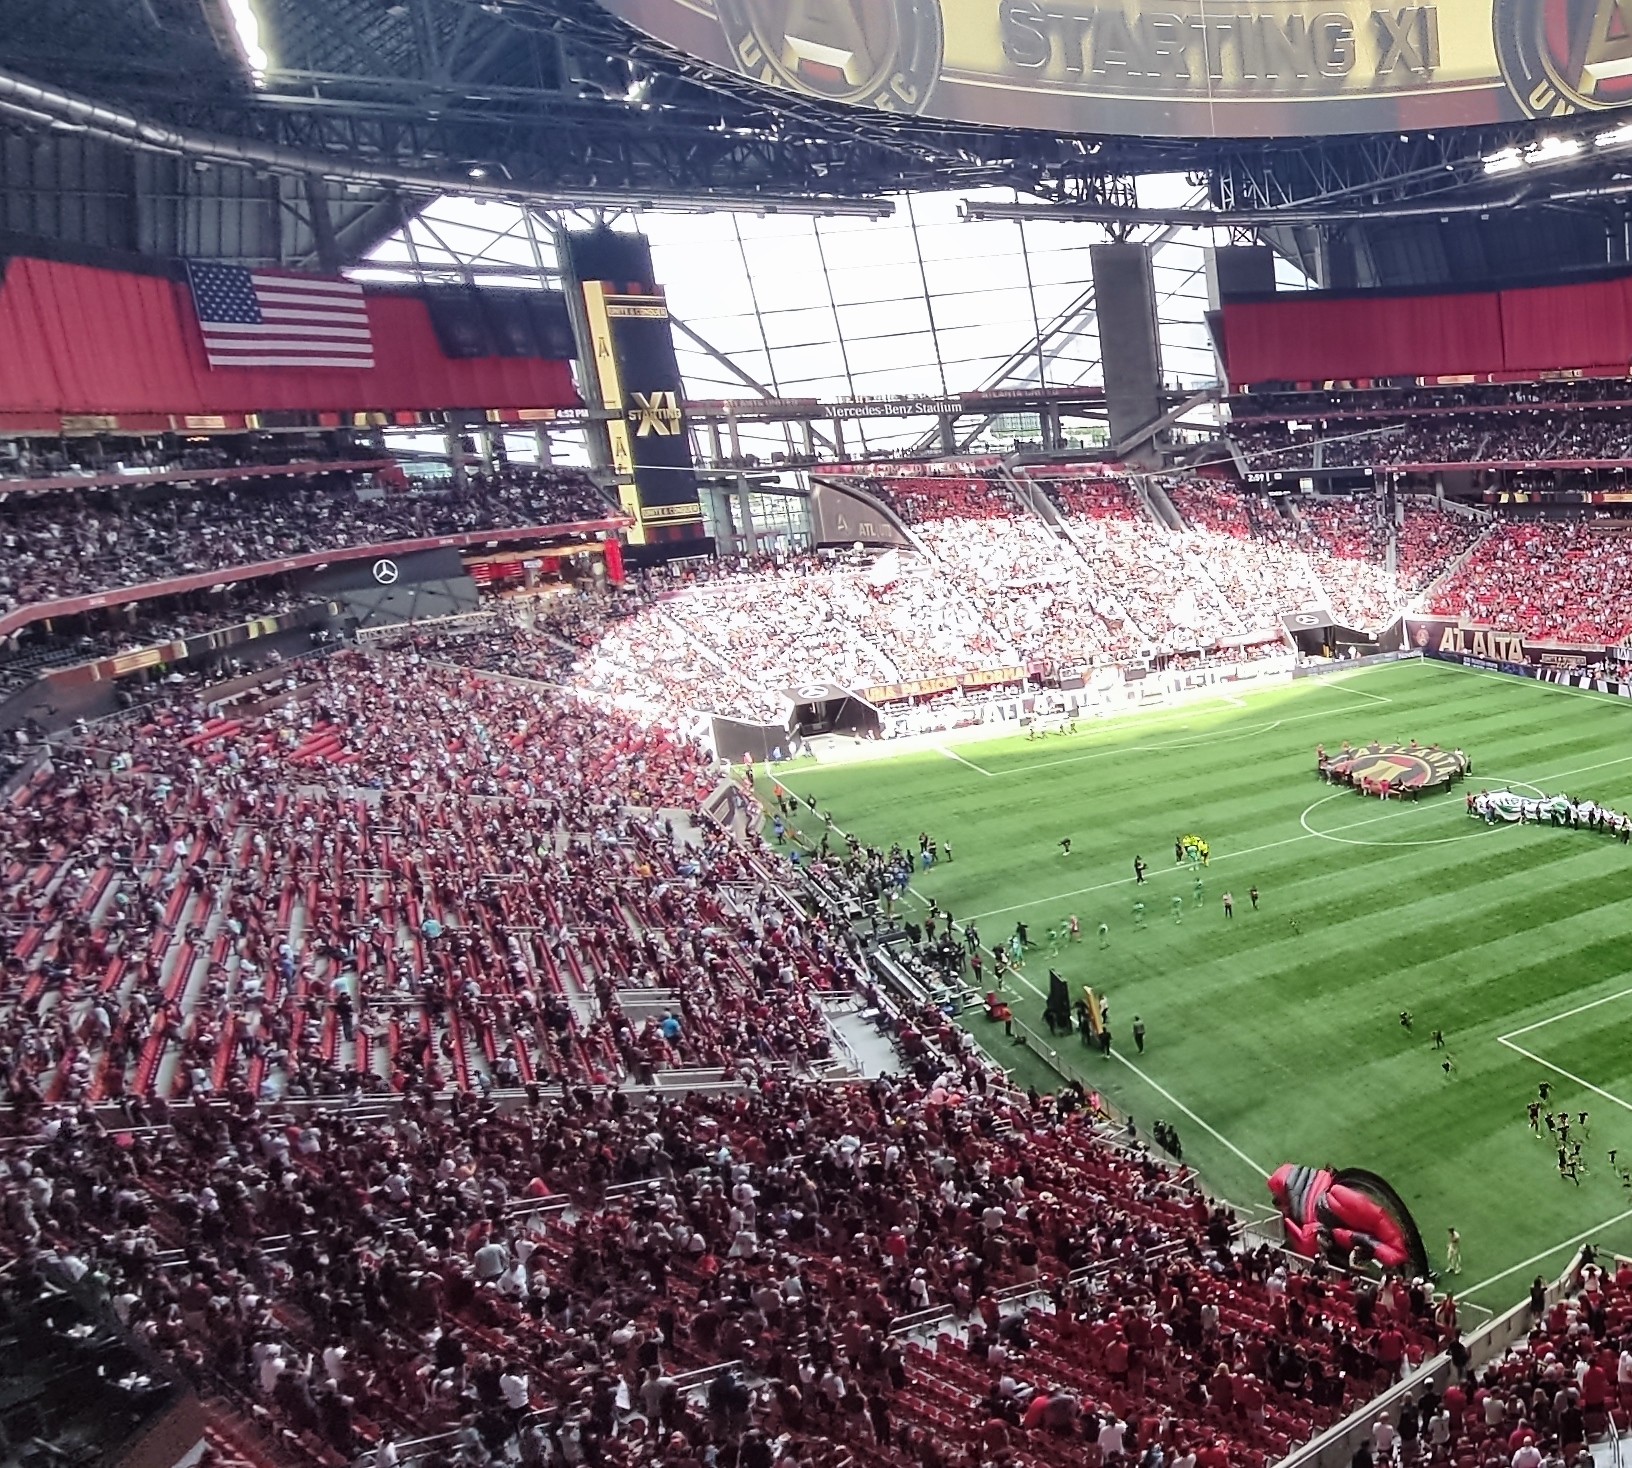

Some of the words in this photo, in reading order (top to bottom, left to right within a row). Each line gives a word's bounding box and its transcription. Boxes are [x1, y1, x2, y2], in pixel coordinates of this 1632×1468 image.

[999, 2, 1357, 79] STARTING
[1368, 5, 1441, 75] XI
[556, 409, 575, 418] 4:52
[575, 409, 589, 418] PM
[628, 407, 681, 421] STARTING
[630, 391, 681, 437] XI
[824, 403, 913, 418] Mercedes-Benz
[915, 402, 963, 414] Stadium
[859, 522, 877, 537] ATL
